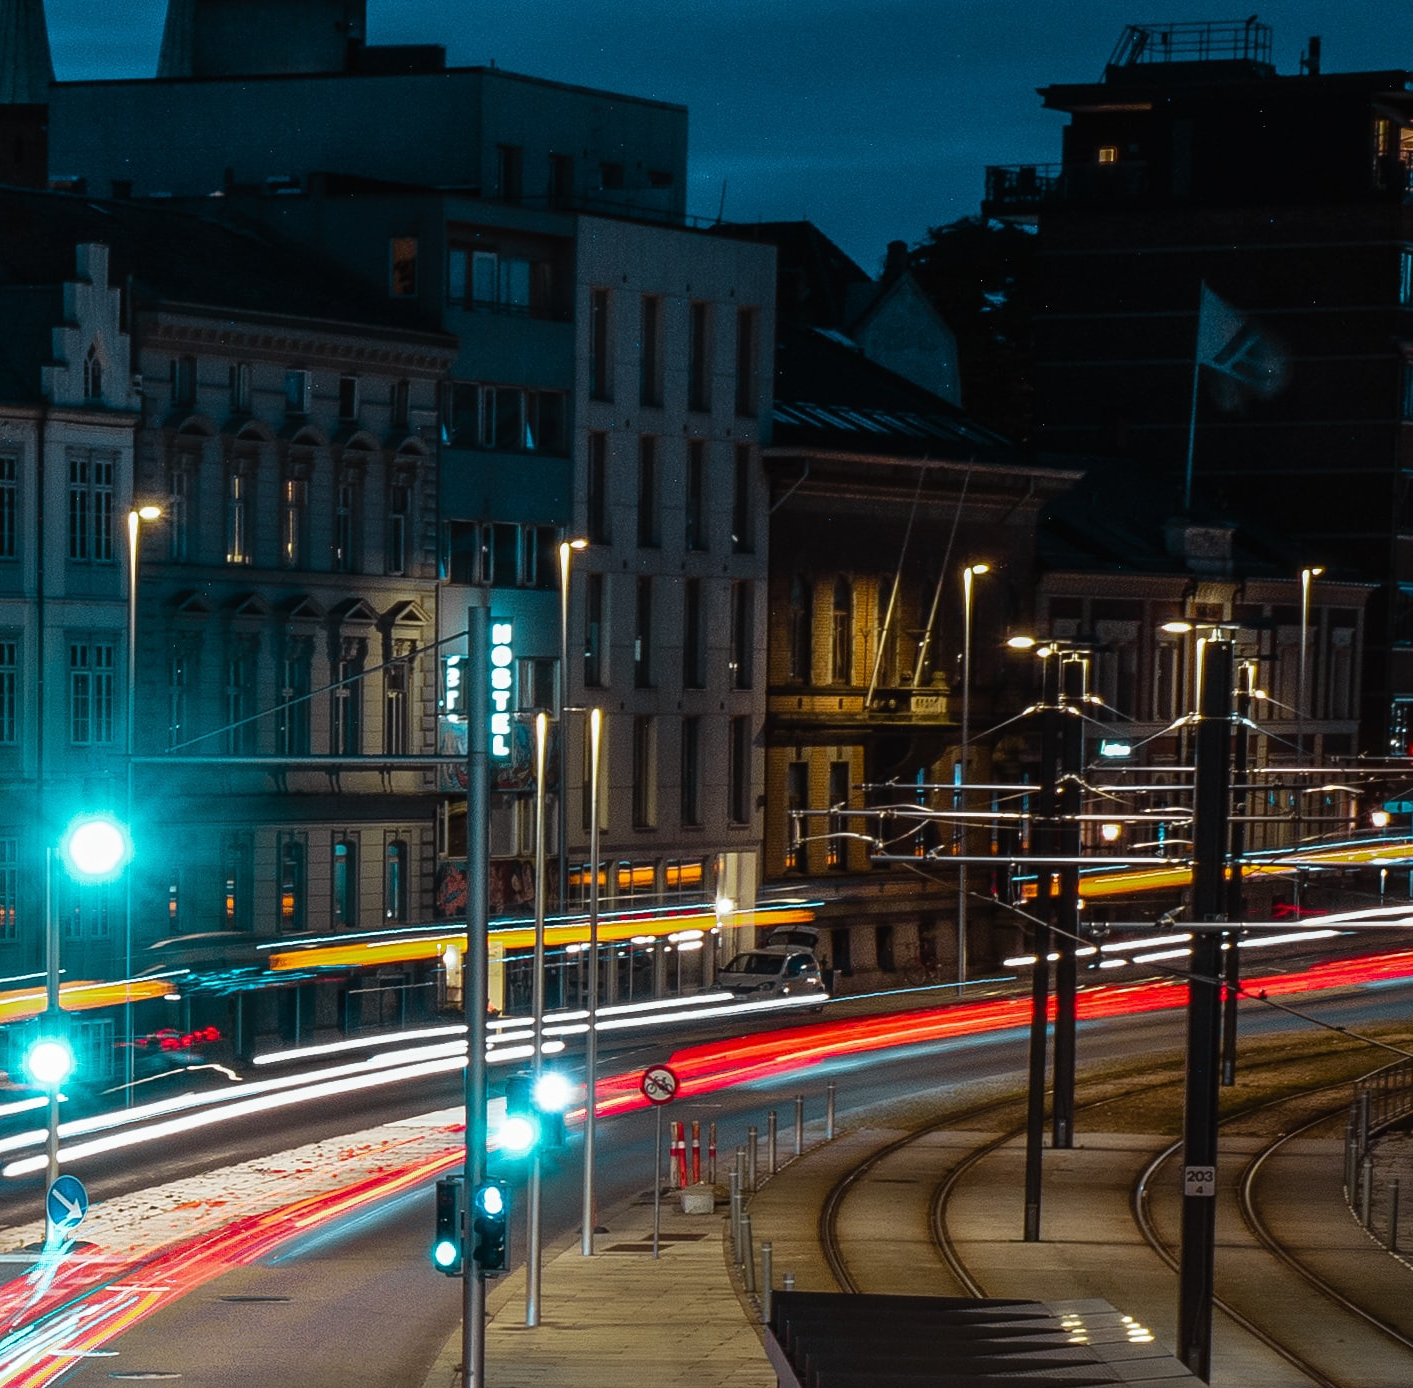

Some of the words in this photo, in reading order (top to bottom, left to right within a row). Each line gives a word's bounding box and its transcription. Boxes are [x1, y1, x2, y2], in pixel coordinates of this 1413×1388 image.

[491, 624, 512, 756] HOSTEL
[1187, 1171, 1213, 1182] 203
[1195, 1186, 1203, 1194] 4
